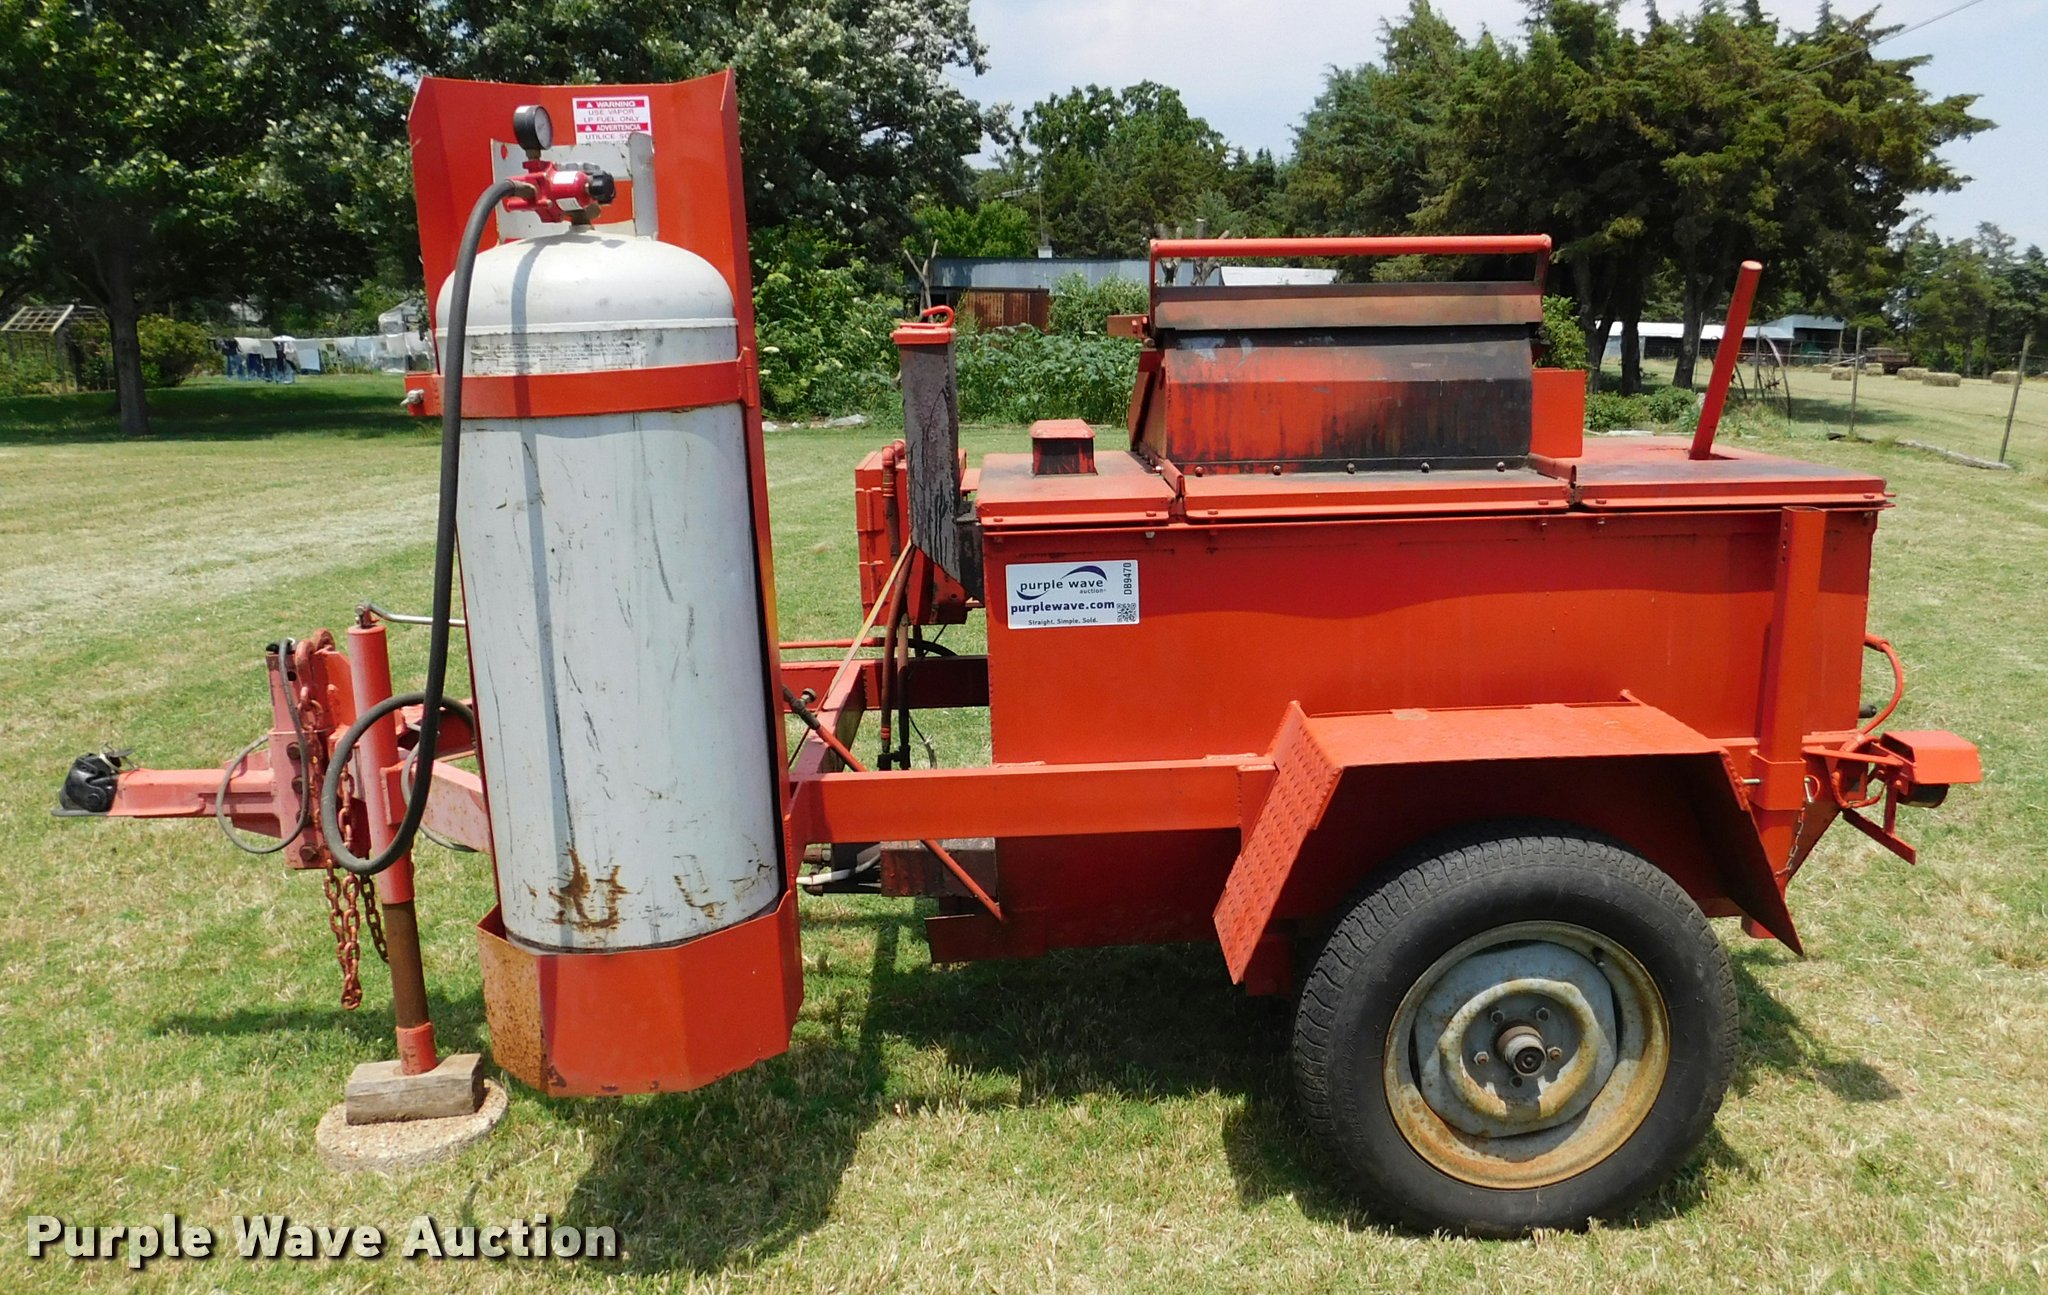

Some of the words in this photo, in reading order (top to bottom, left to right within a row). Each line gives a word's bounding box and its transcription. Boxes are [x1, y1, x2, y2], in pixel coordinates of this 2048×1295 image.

[595, 100, 636, 108] WARNING
[595, 124, 642, 132] ADVERTENCIA
[1123, 562, 1132, 595] DB9470
[1020, 579, 1064, 592] purple
[1068, 579, 1104, 588] wave
[1011, 601, 1115, 615] purplewave.com
[1028, 618, 1056, 626] Straight.
[1057, 617, 1081, 625] Simple.
[1082, 616, 1098, 624] Sold.
